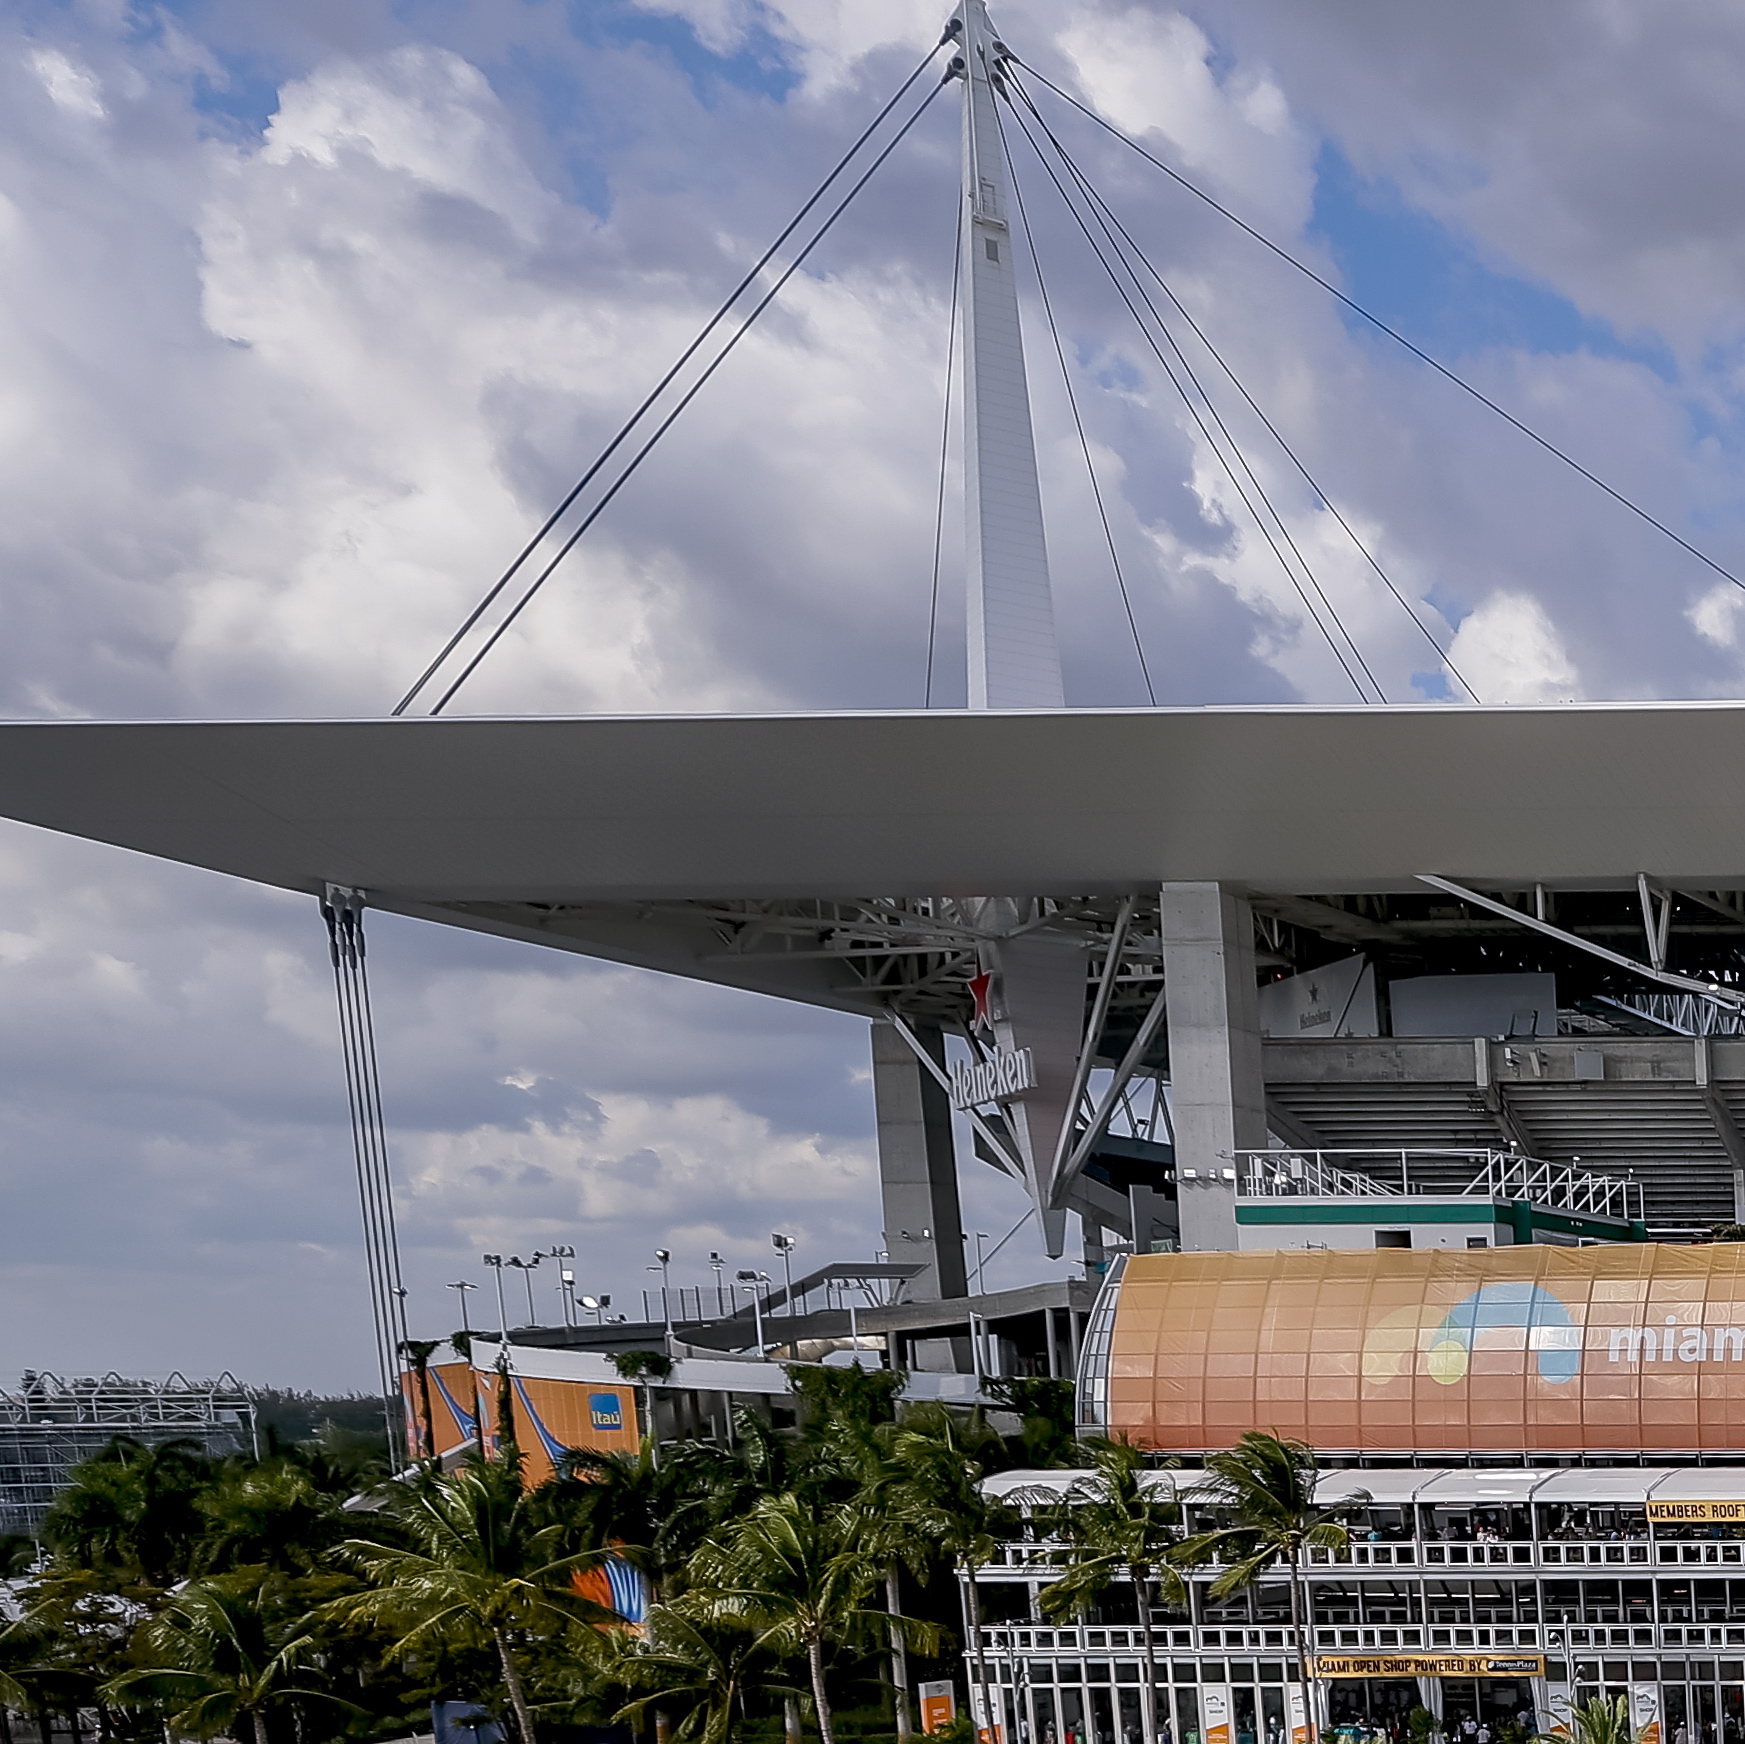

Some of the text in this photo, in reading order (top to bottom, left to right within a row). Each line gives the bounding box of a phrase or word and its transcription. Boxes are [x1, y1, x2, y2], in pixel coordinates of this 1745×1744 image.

[592, 1411, 621, 1425] Itaú
[1648, 1504, 1706, 1518] MEMBERS
[1316, 1659, 1482, 1672] MIAMI OPEN SHOP POWERED BY
